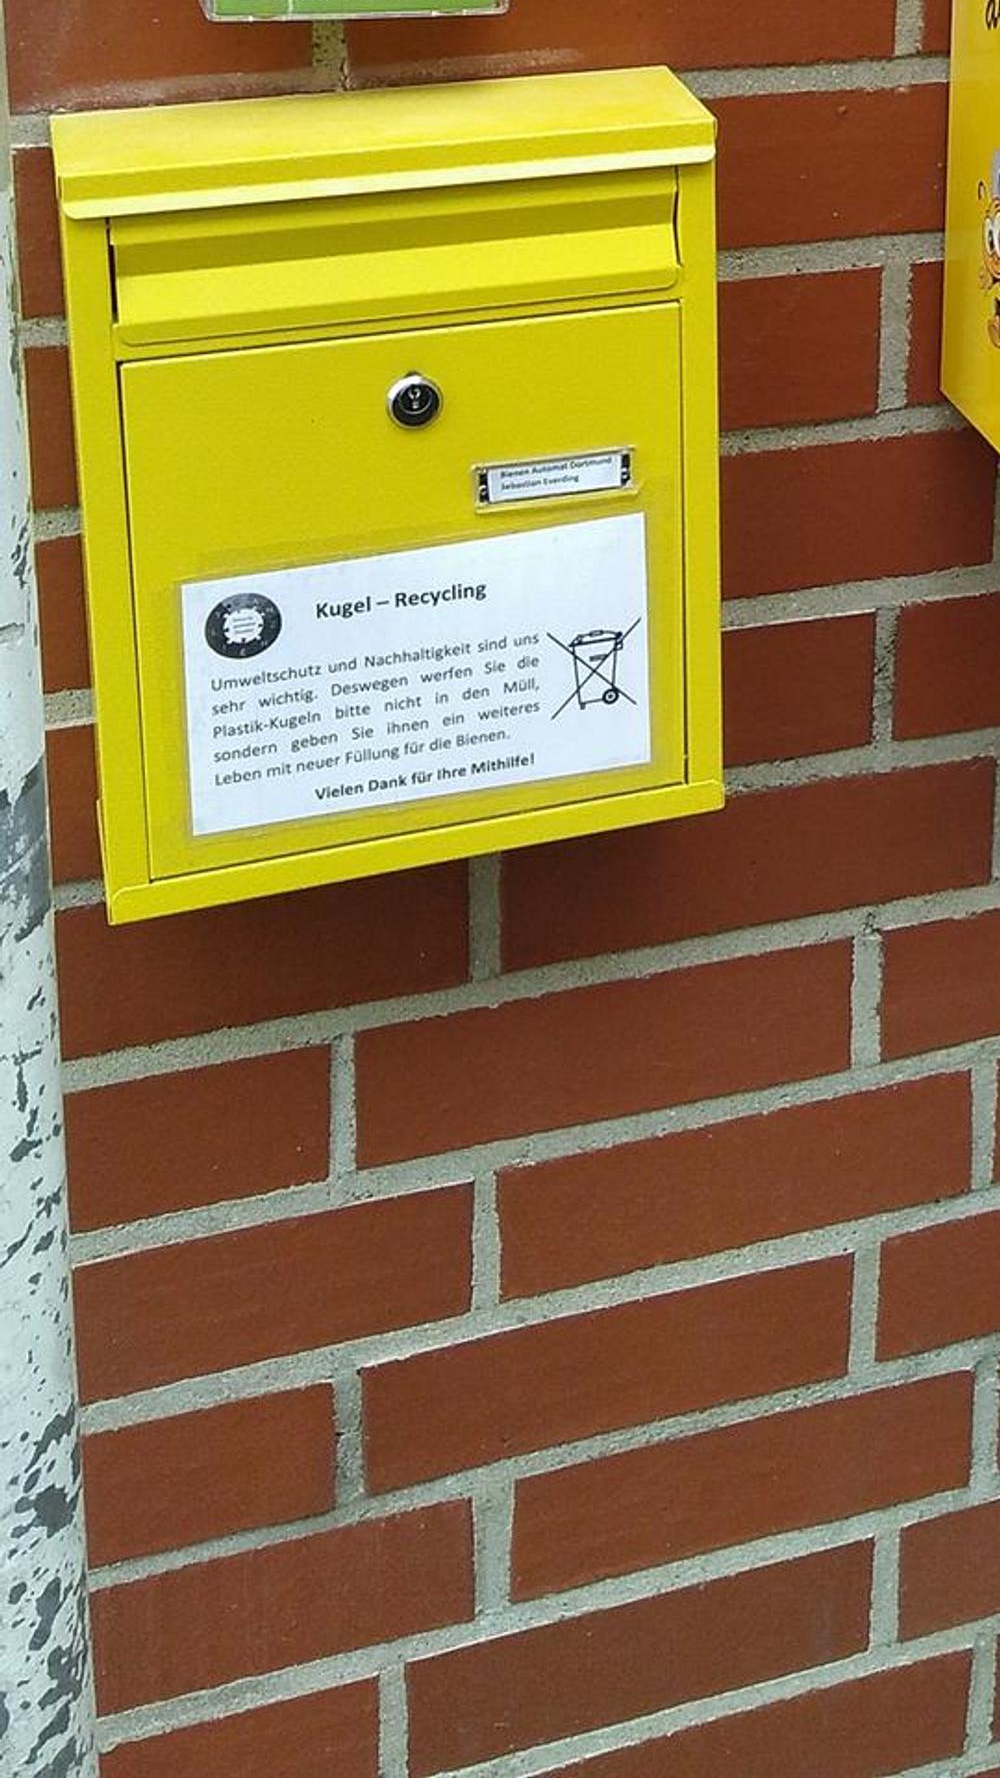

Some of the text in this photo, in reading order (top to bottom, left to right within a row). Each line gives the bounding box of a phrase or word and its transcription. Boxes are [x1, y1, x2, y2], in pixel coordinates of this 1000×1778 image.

[501, 457, 613, 478] Bienen Automat Dortmund
[502, 479, 542, 490] Sebastian
[316, 596, 372, 619] Kugel
[395, 584, 488, 608] Recycling
[211, 633, 540, 692] Umweltschutz und Nachhaltigkeit sind uns
[212, 655, 540, 716] sehr wichtig. Deswegen werfen Sie die
[213, 677, 540, 739] Plastik-Kugeln bitte nicht in den Müll,
[214, 743, 277, 763] sondern
[291, 733, 338, 753] geben
[351, 725, 374, 740] Sie
[442, 713, 465, 727] ein
[478, 701, 540, 721] weiteres
[215, 729, 510, 786] Leben mit neuer Füllung für die Bienen.
[315, 752, 535, 800] Vielen Dank für Ihre Mithilfe!
